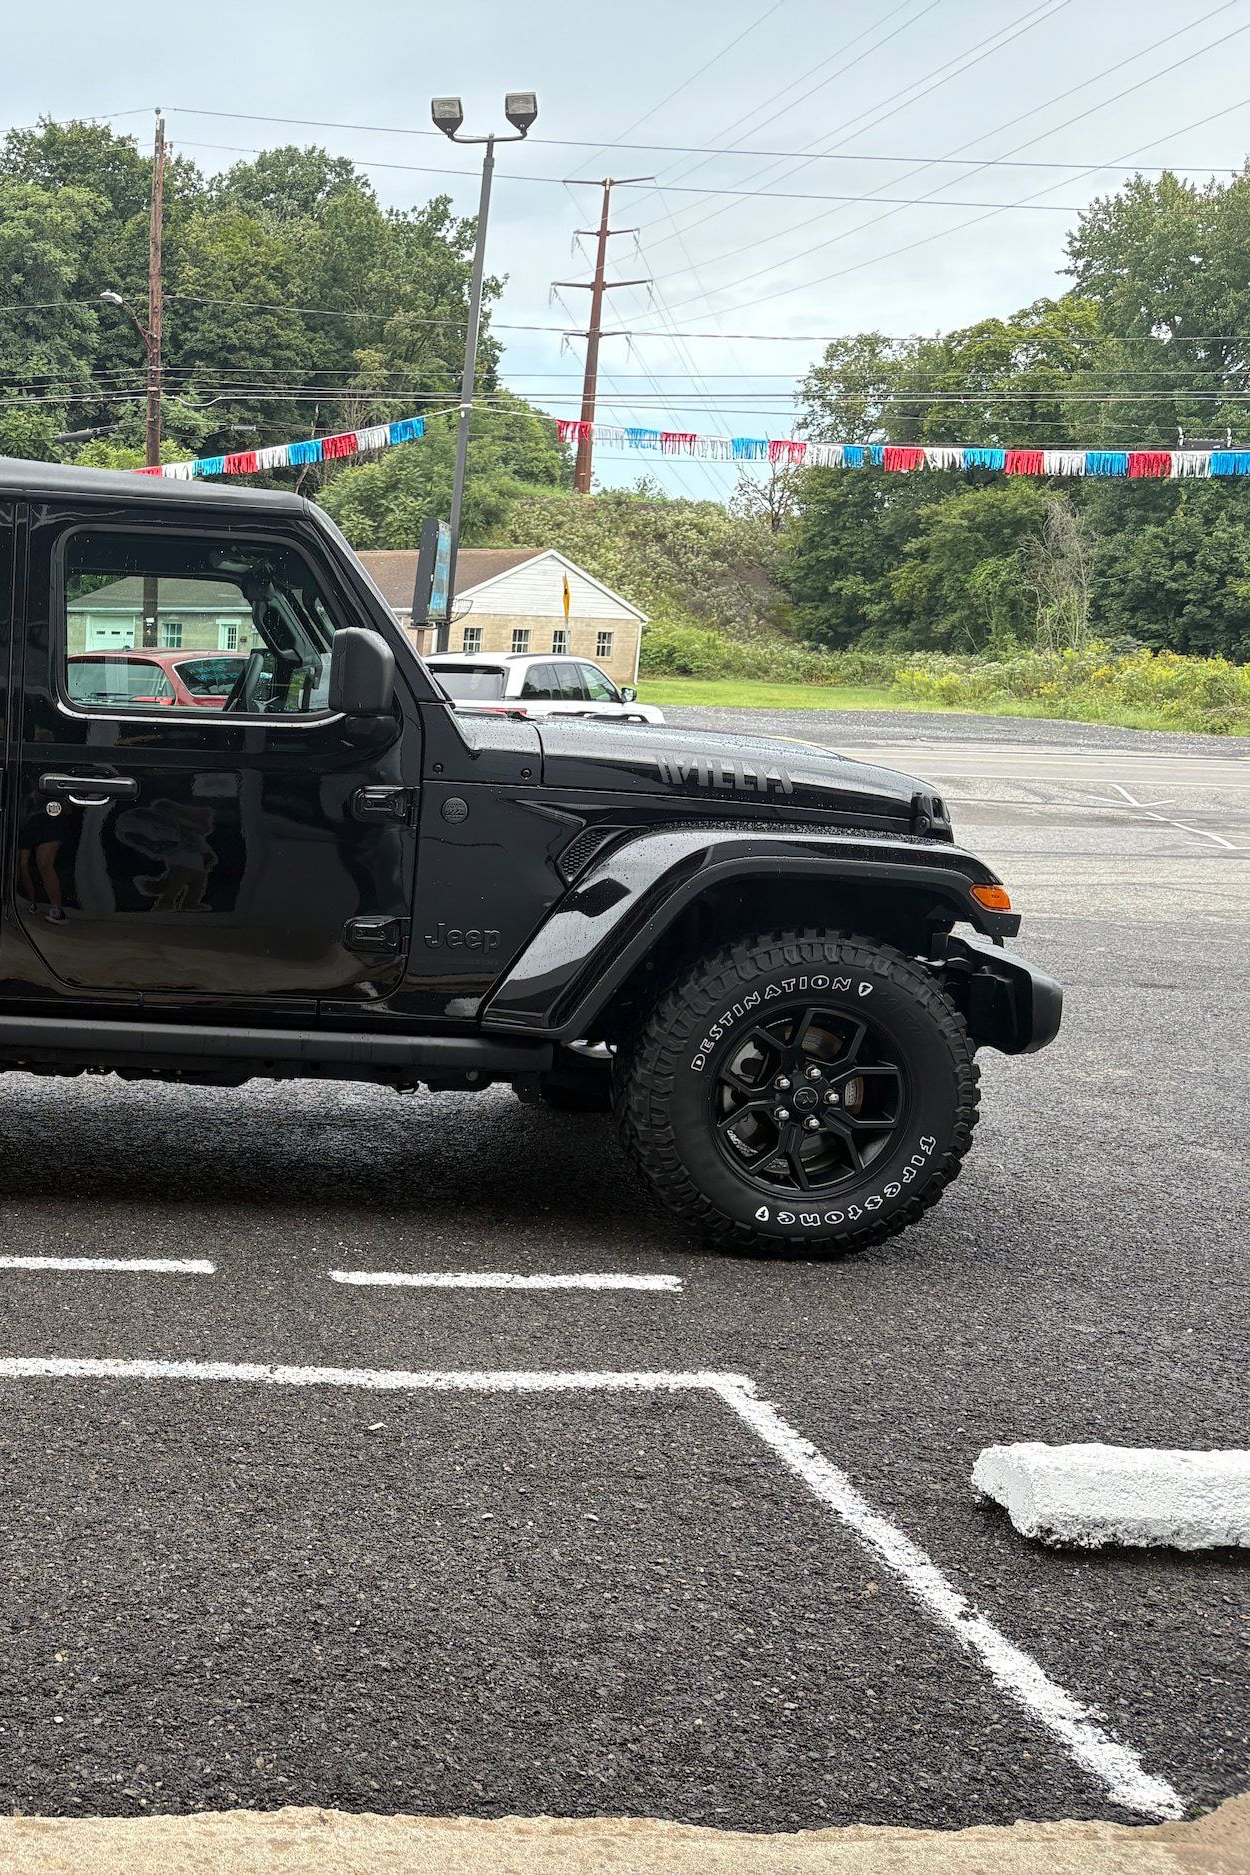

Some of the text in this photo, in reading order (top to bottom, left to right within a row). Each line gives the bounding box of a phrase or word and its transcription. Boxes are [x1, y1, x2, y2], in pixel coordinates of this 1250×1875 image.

[654, 753, 794, 794] WILLYS
[424, 922, 501, 954] Jeep
[691, 975, 852, 1072] DESTINATION
